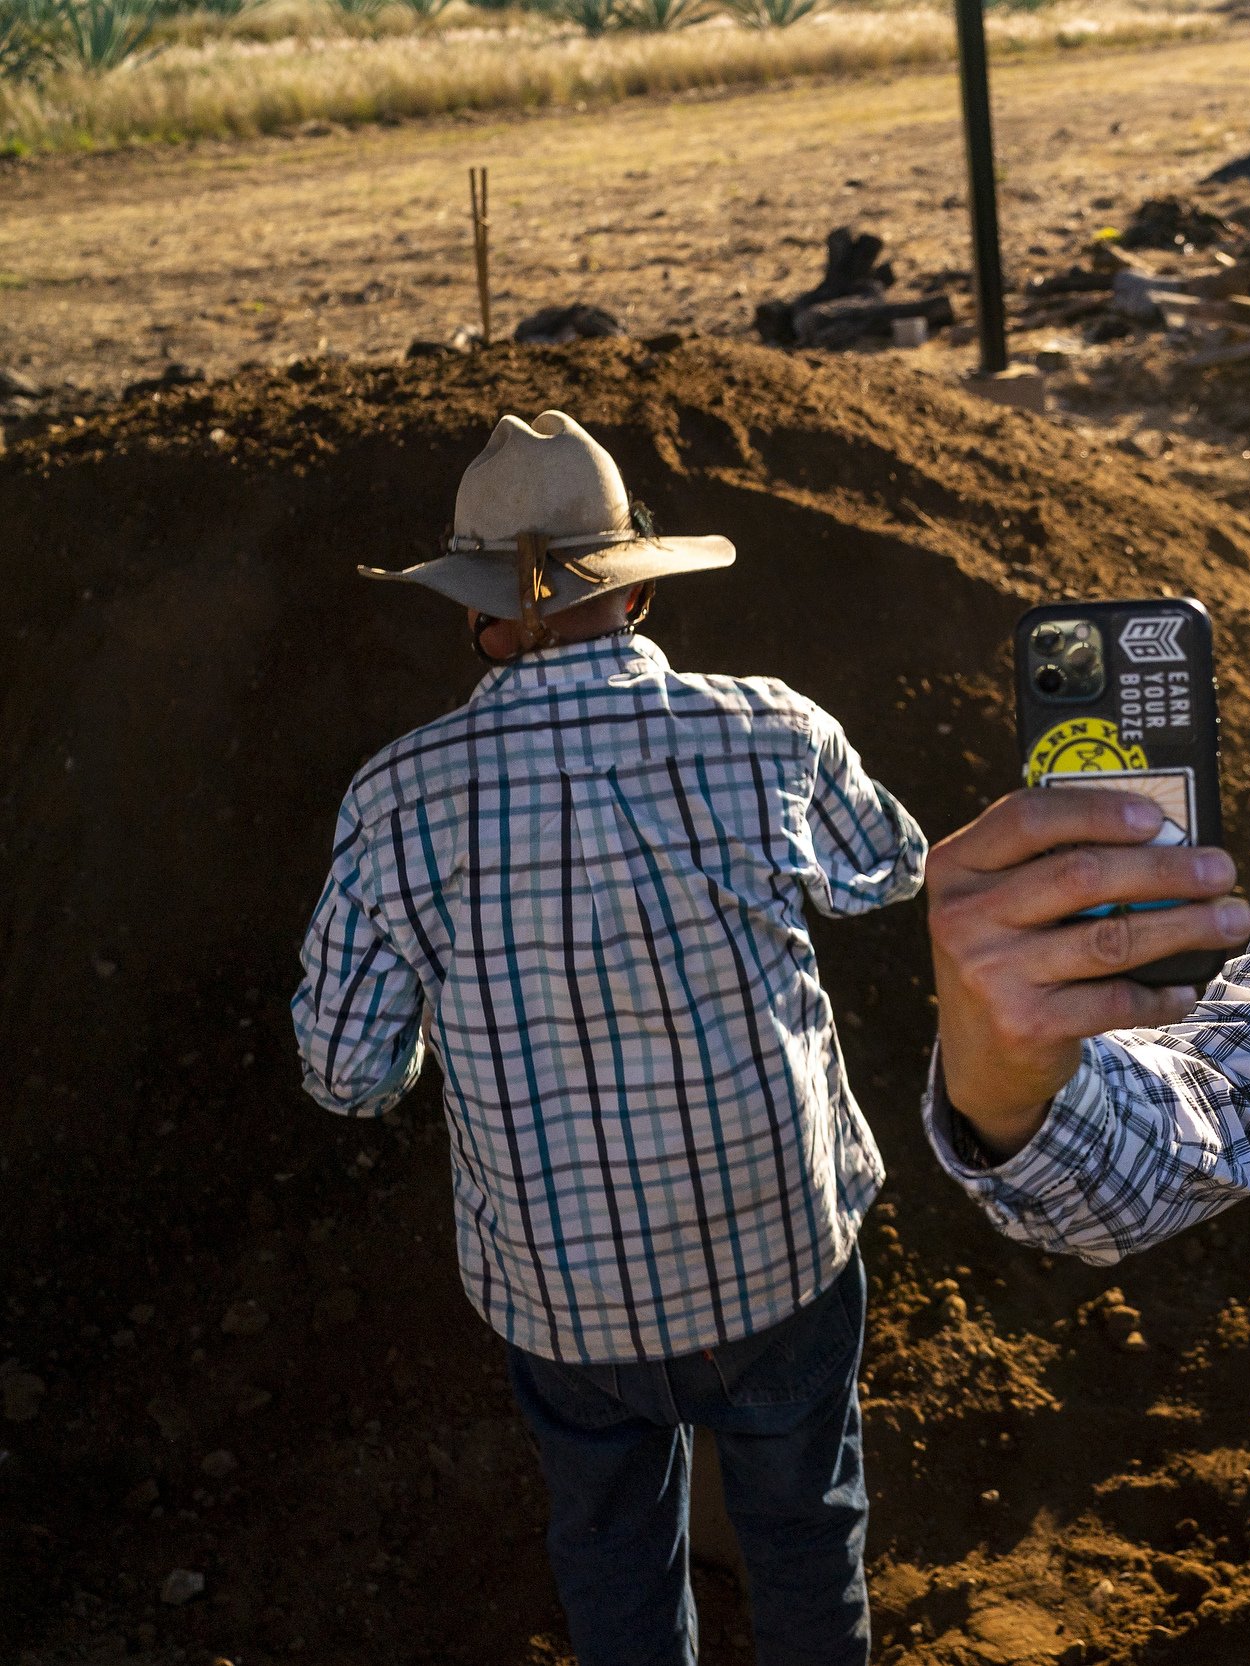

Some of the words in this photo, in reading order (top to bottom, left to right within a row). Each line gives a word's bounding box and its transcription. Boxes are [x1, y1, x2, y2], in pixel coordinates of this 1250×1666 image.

[1120, 673, 1144, 742] BOOZE
[1145, 672, 1167, 729] YOUR
[1168, 671, 1191, 727] EARN
